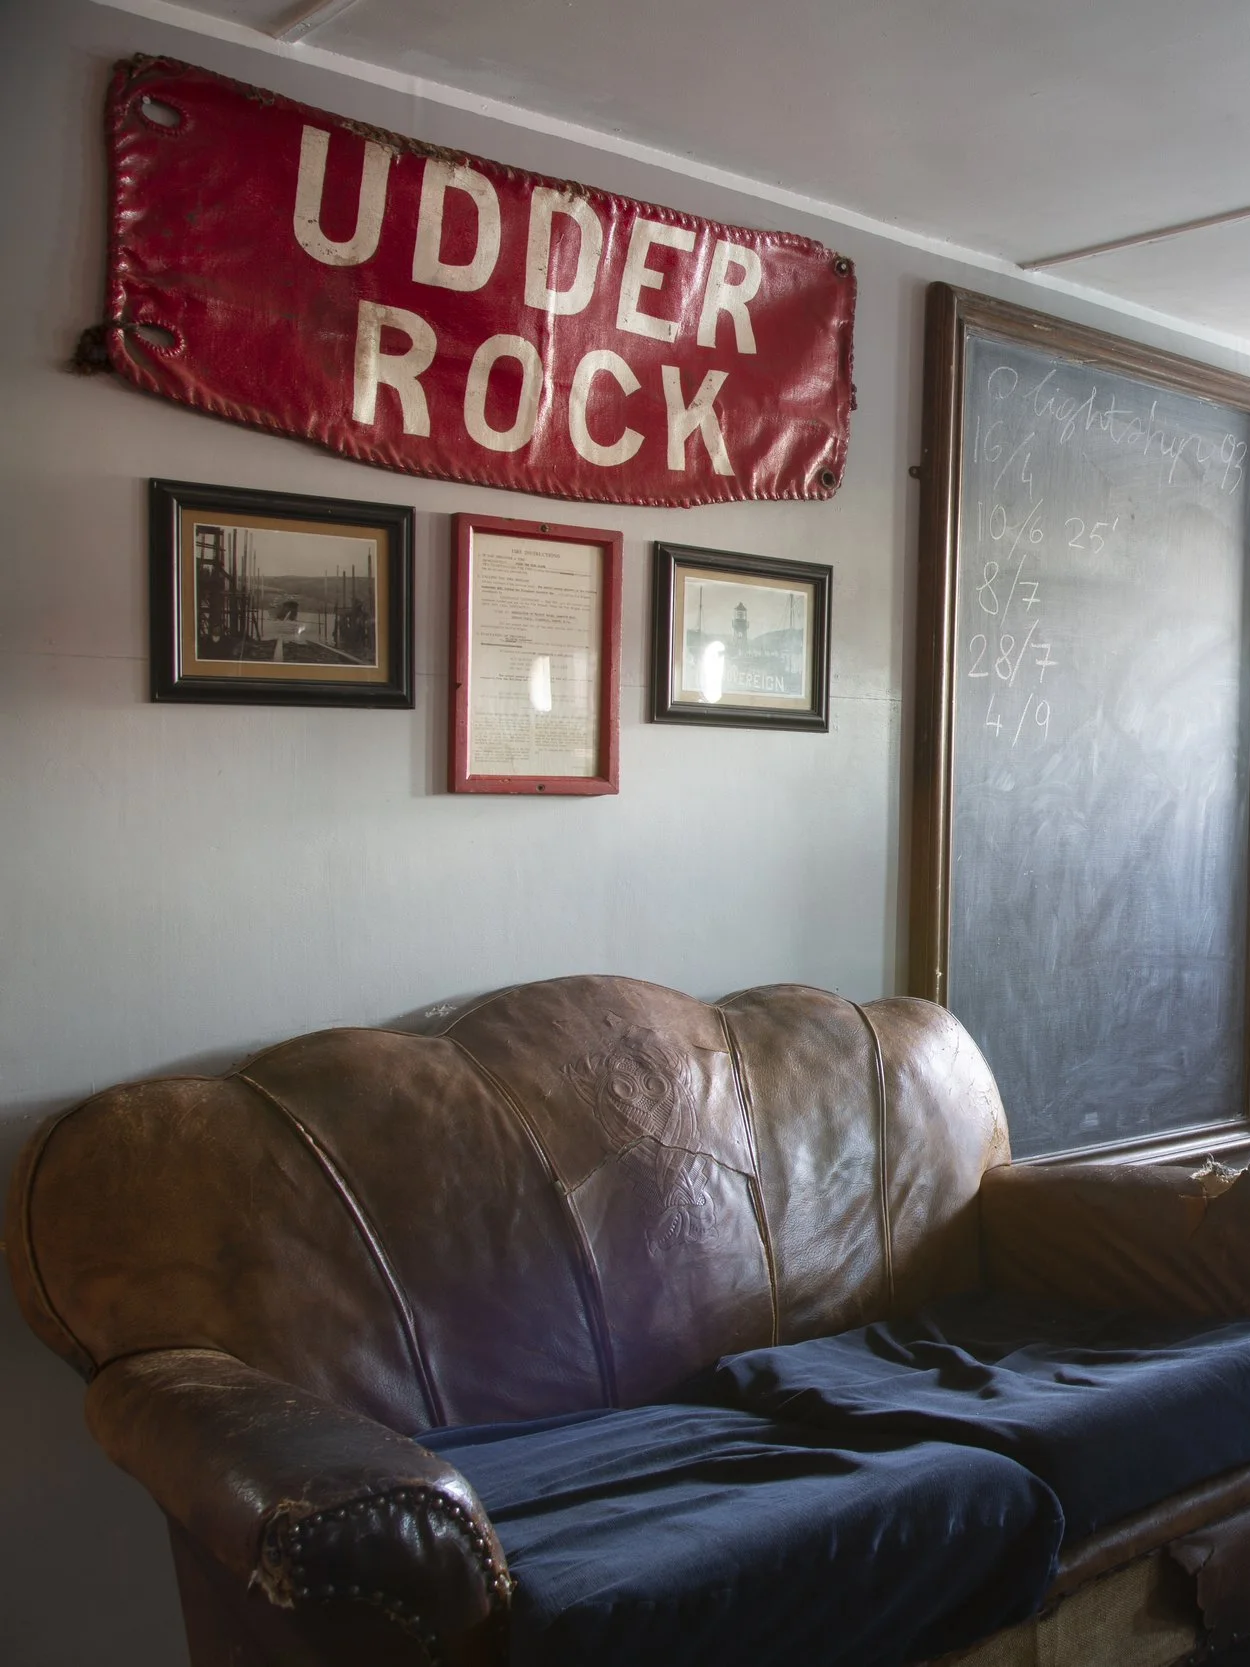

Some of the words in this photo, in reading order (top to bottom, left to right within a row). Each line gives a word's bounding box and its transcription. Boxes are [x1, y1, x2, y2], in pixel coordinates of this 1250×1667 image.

[292, 124, 763, 354] UDDER
[352, 300, 735, 477] ROCK
[975, 553, 1041, 628] 8/7
[967, 618, 1060, 688] 28/7
[985, 692, 1052, 749] 4/9
